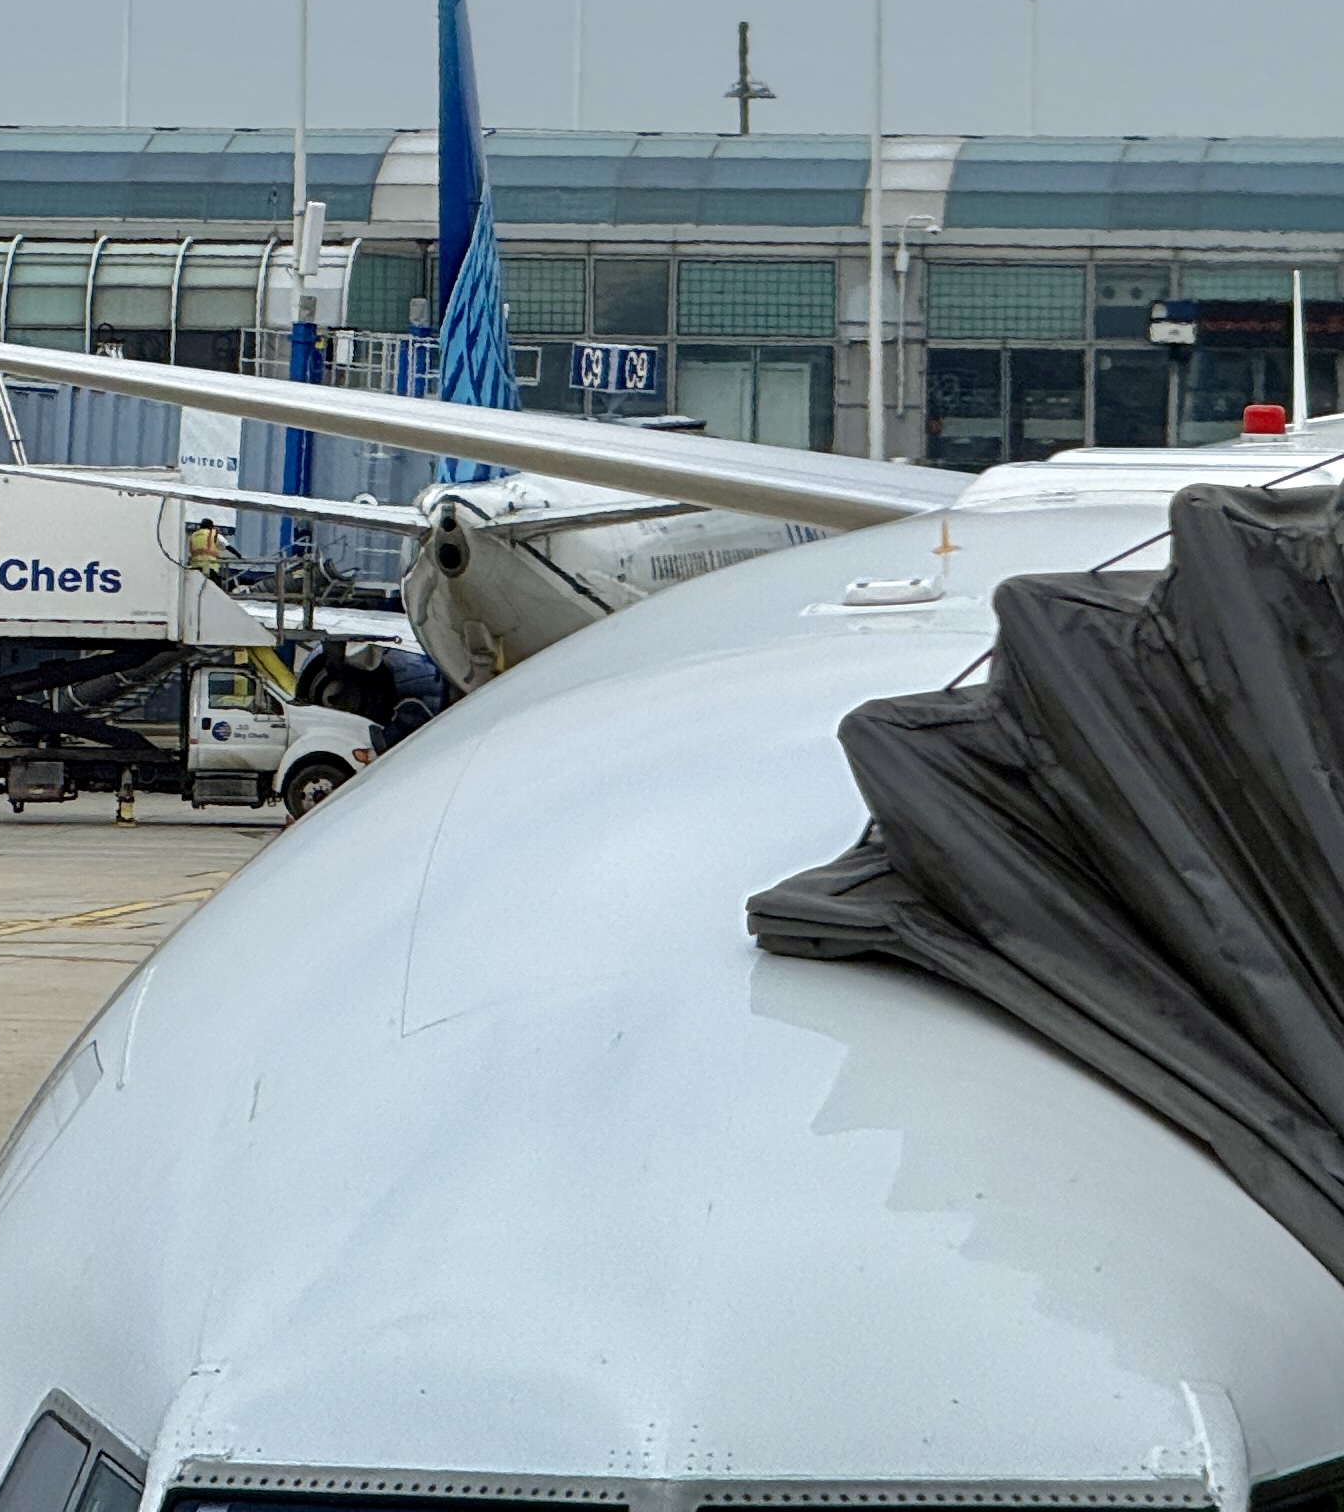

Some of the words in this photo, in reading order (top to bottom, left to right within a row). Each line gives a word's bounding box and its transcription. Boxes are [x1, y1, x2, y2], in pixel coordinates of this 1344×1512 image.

[581, 348, 603, 387] C9
[625, 351, 648, 388] C9
[181, 456, 224, 468] UNITED
